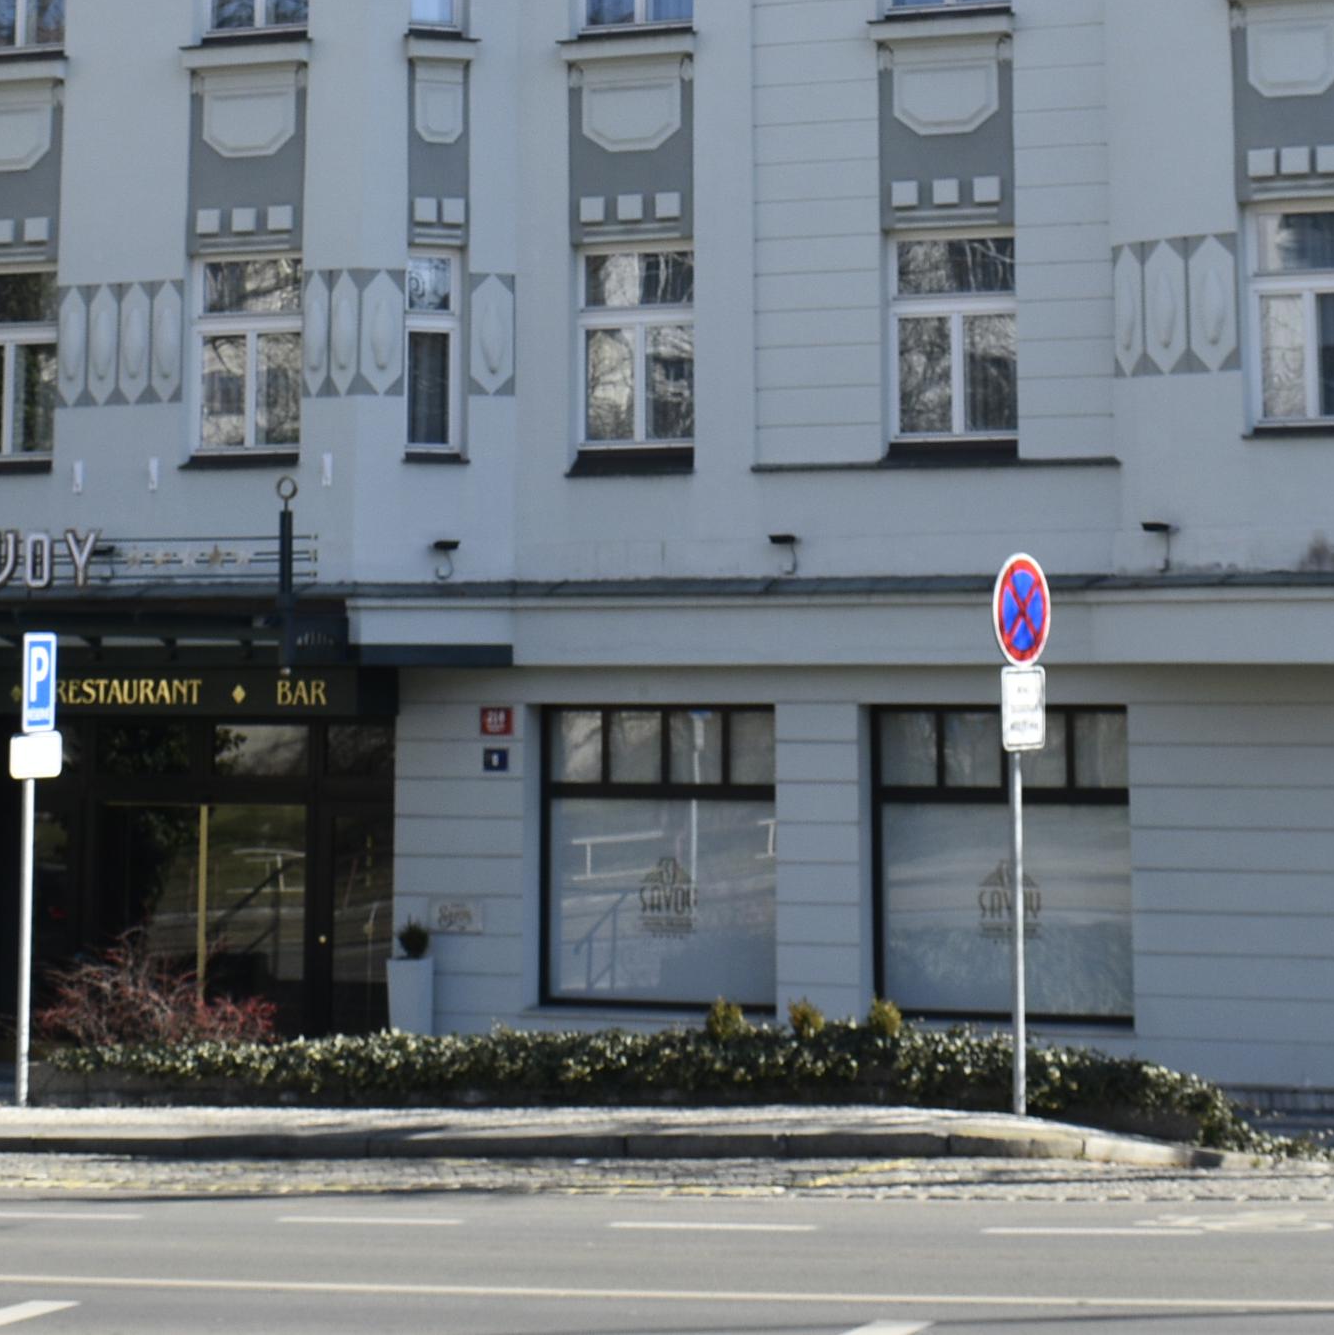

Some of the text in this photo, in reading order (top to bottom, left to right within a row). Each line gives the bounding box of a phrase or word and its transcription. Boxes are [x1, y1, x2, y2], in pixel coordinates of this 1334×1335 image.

[28, 646, 49, 703] P
[55, 678, 202, 704] RESTAURANT
[277, 679, 327, 706] BAR
[639, 885, 699, 916] SAVOY
[978, 889, 1042, 918] SAVY
